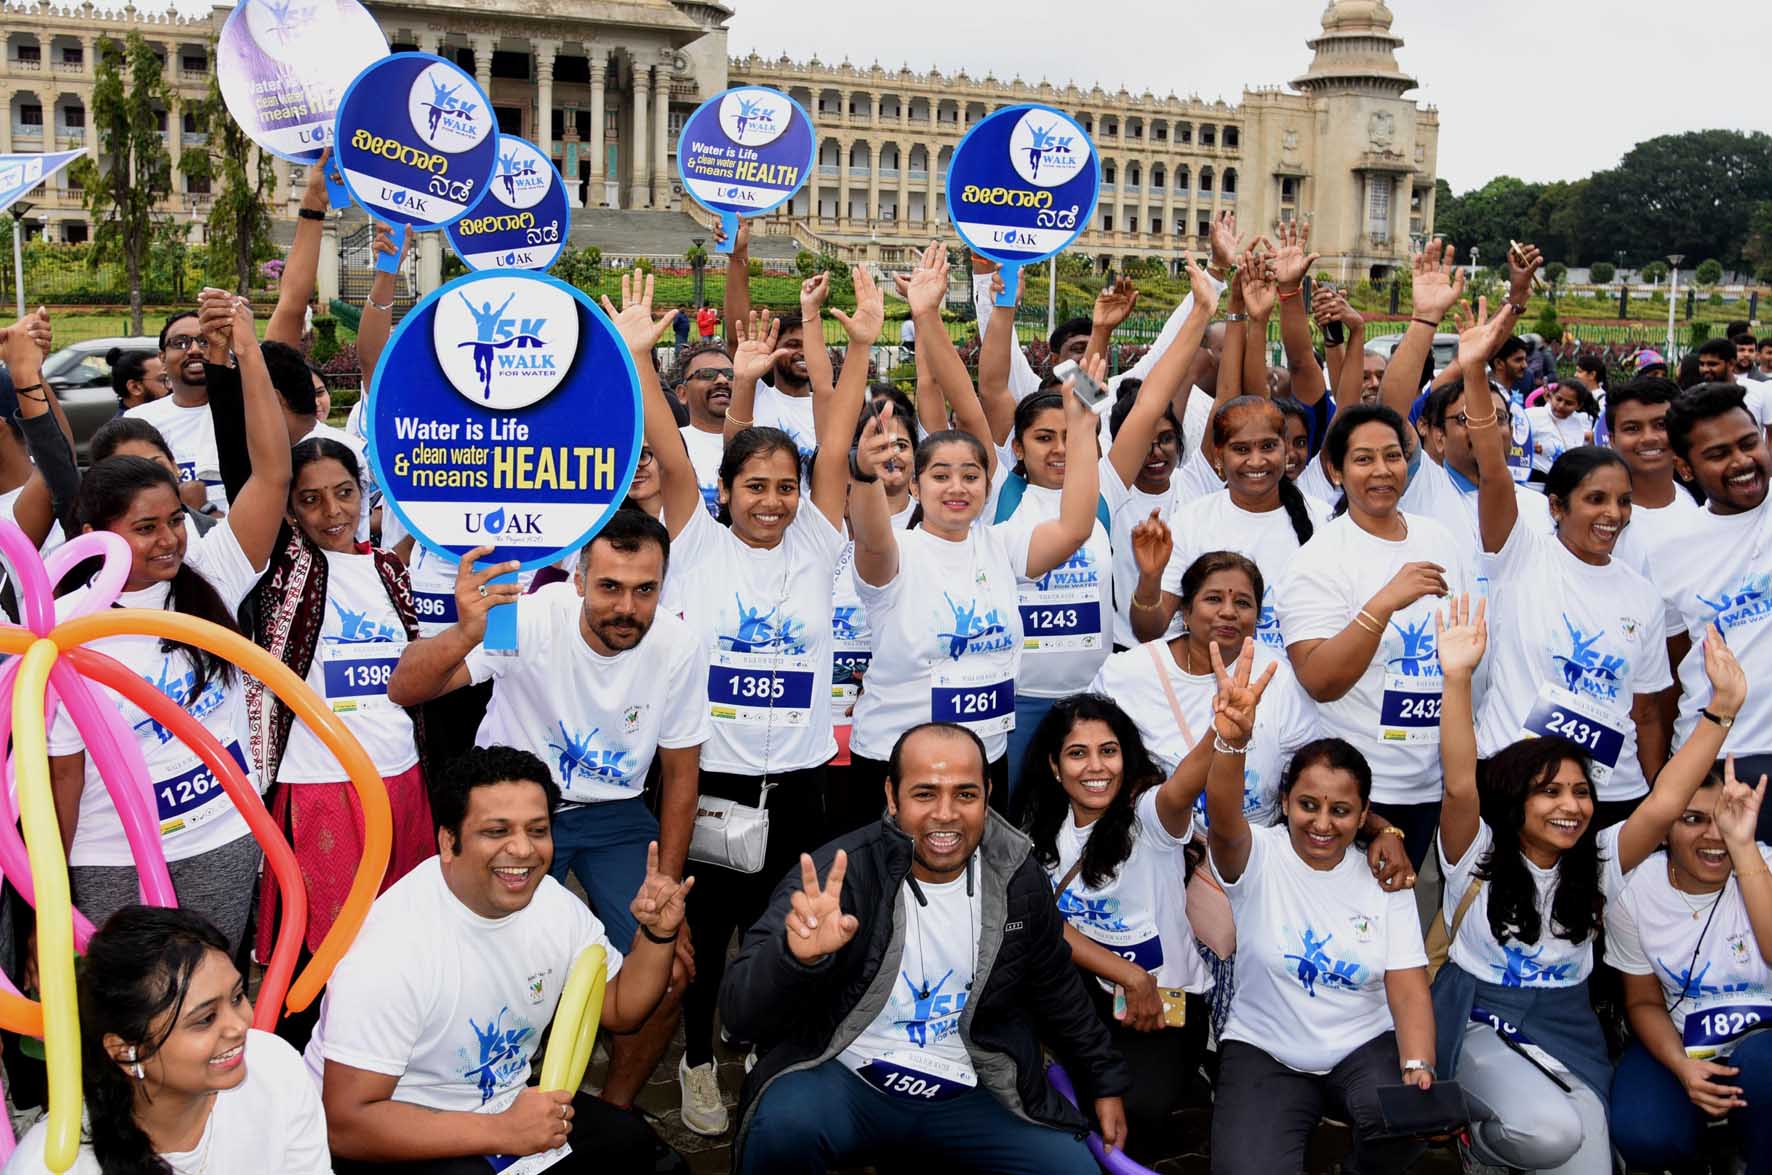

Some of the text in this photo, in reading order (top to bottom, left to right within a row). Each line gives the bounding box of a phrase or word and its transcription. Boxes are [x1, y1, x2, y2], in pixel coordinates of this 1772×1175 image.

[445, 96, 478, 121] 5K
[443, 117, 477, 136] WALK
[748, 122, 776, 132] WALK
[351, 129, 448, 175] ನೀರಿಗಾಗಿ
[691, 142, 758, 161] Water is Life
[1043, 136, 1075, 154] 5K
[512, 159, 537, 176] 5K
[687, 157, 696, 168] &
[697, 154, 716, 166] clean
[1043, 154, 1076, 165] WALK
[516, 176, 544, 188] WALK
[695, 161, 798, 186] means HEALTH
[429, 175, 474, 202] ನಡೆ
[961, 184, 1053, 209] ನೀರಿಗಾಗಿ
[1037, 205, 1079, 229] ನಡೆ
[526, 220, 559, 244] ನಡೆ
[494, 318, 548, 349] 5K
[498, 354, 555, 369] WALK
[394, 417, 529, 441] Water is Life
[394, 441, 489, 477] & clean water
[412, 446, 615, 491] means HEALTH
[1054, 571, 1097, 585] WALK
[414, 597, 445, 616] 396
[1029, 610, 1078, 629] 1243
[970, 634, 1013, 653] WALK
[1422, 664, 1444, 677] WA
[1583, 649, 1624, 680] 5K
[729, 675, 785, 698] 1385
[951, 690, 997, 714] 1261
[1545, 711, 1602, 749] 2431
[583, 750, 626, 777] 5K
[884, 1072, 941, 1099] 1504
